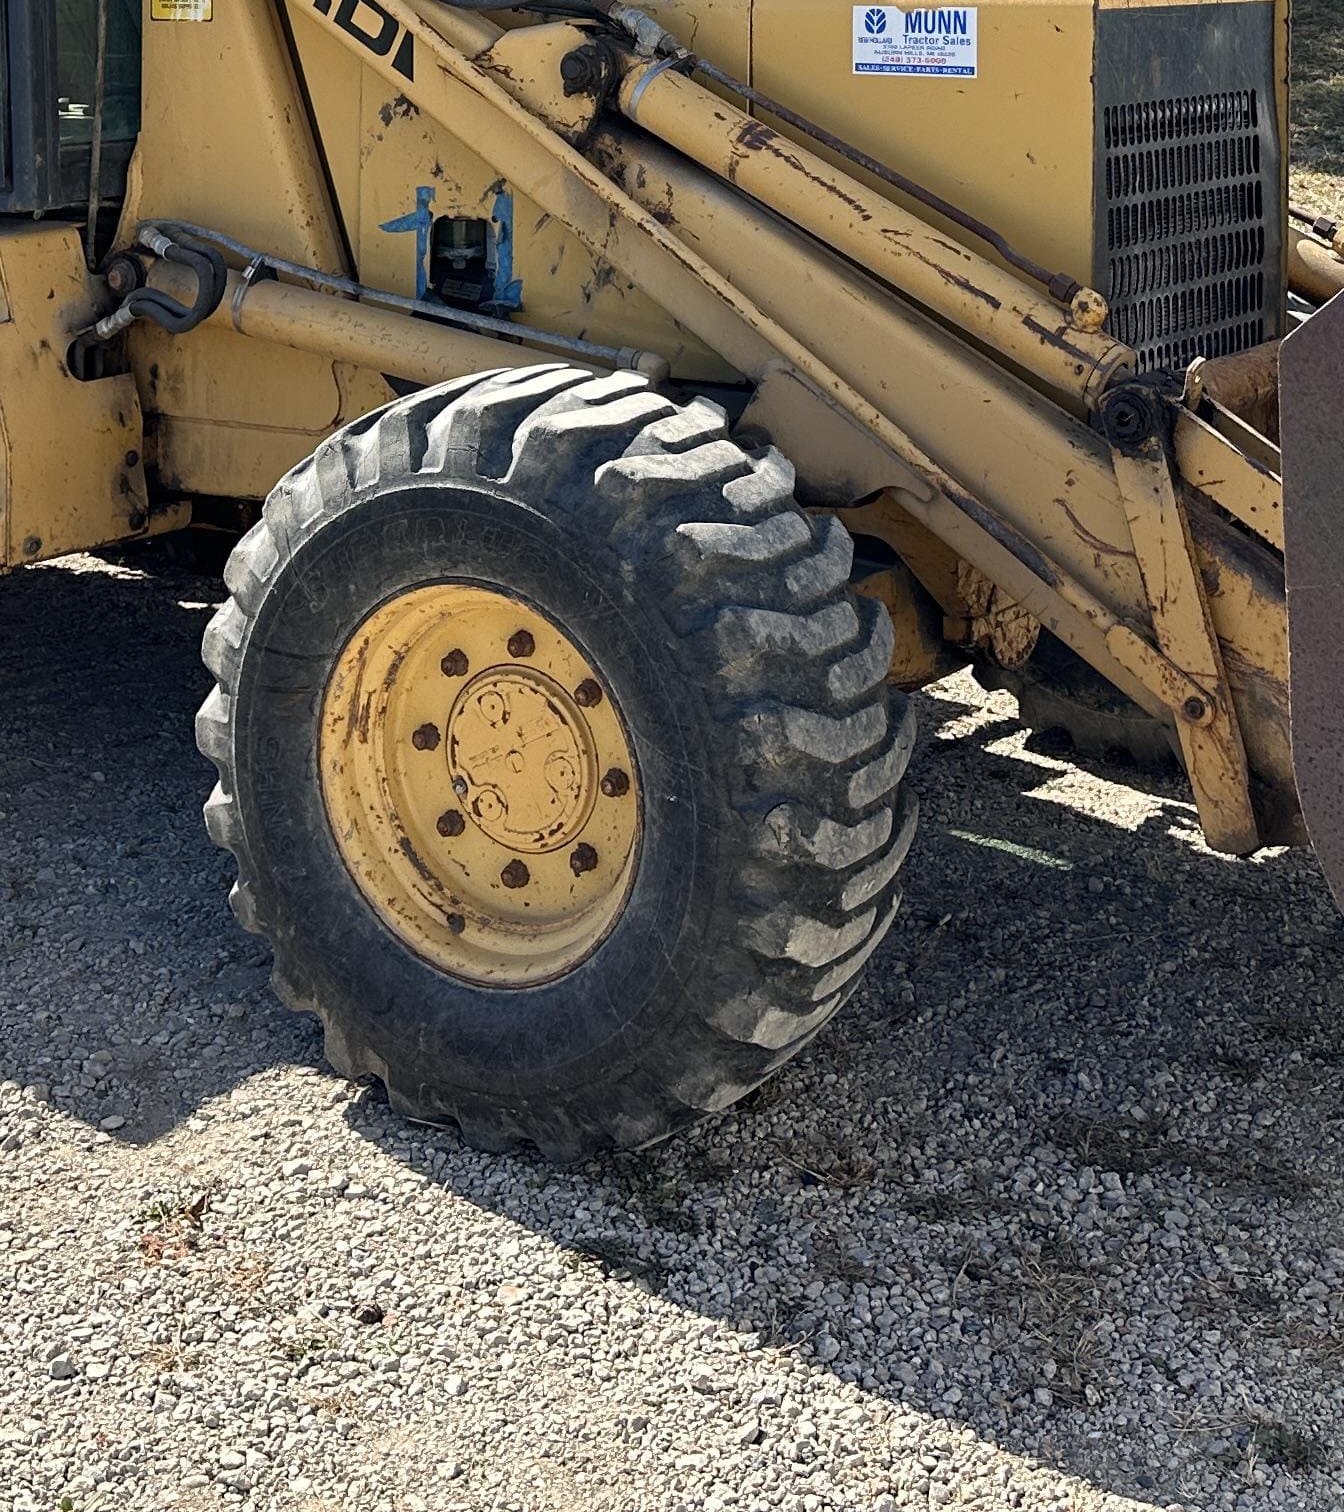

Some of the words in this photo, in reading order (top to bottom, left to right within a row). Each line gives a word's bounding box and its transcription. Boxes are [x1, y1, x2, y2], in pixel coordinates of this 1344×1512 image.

[904, 9, 967, 35] MUNN
[903, 34, 939, 45] Tractor
[942, 35, 971, 46] Sales
